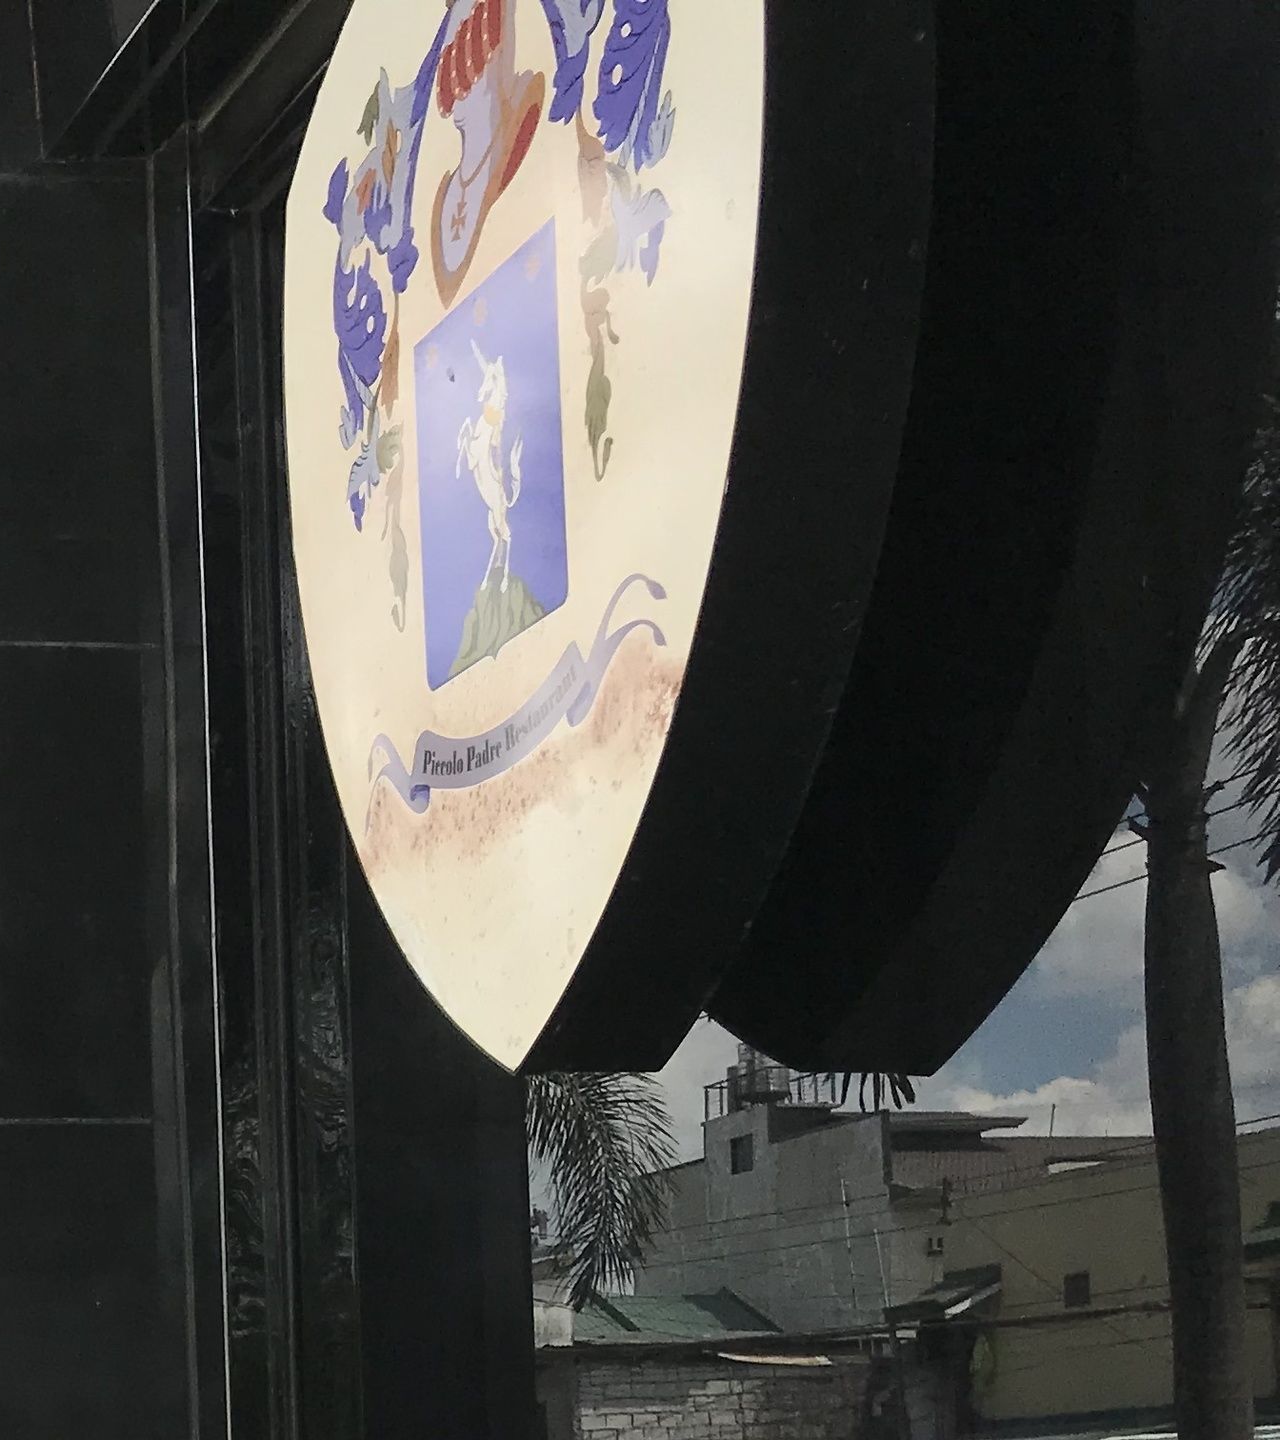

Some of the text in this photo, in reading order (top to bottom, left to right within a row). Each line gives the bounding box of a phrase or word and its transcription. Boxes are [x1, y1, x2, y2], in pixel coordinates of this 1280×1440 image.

[423, 664, 577, 776] Piccolo Padre Restaurant
